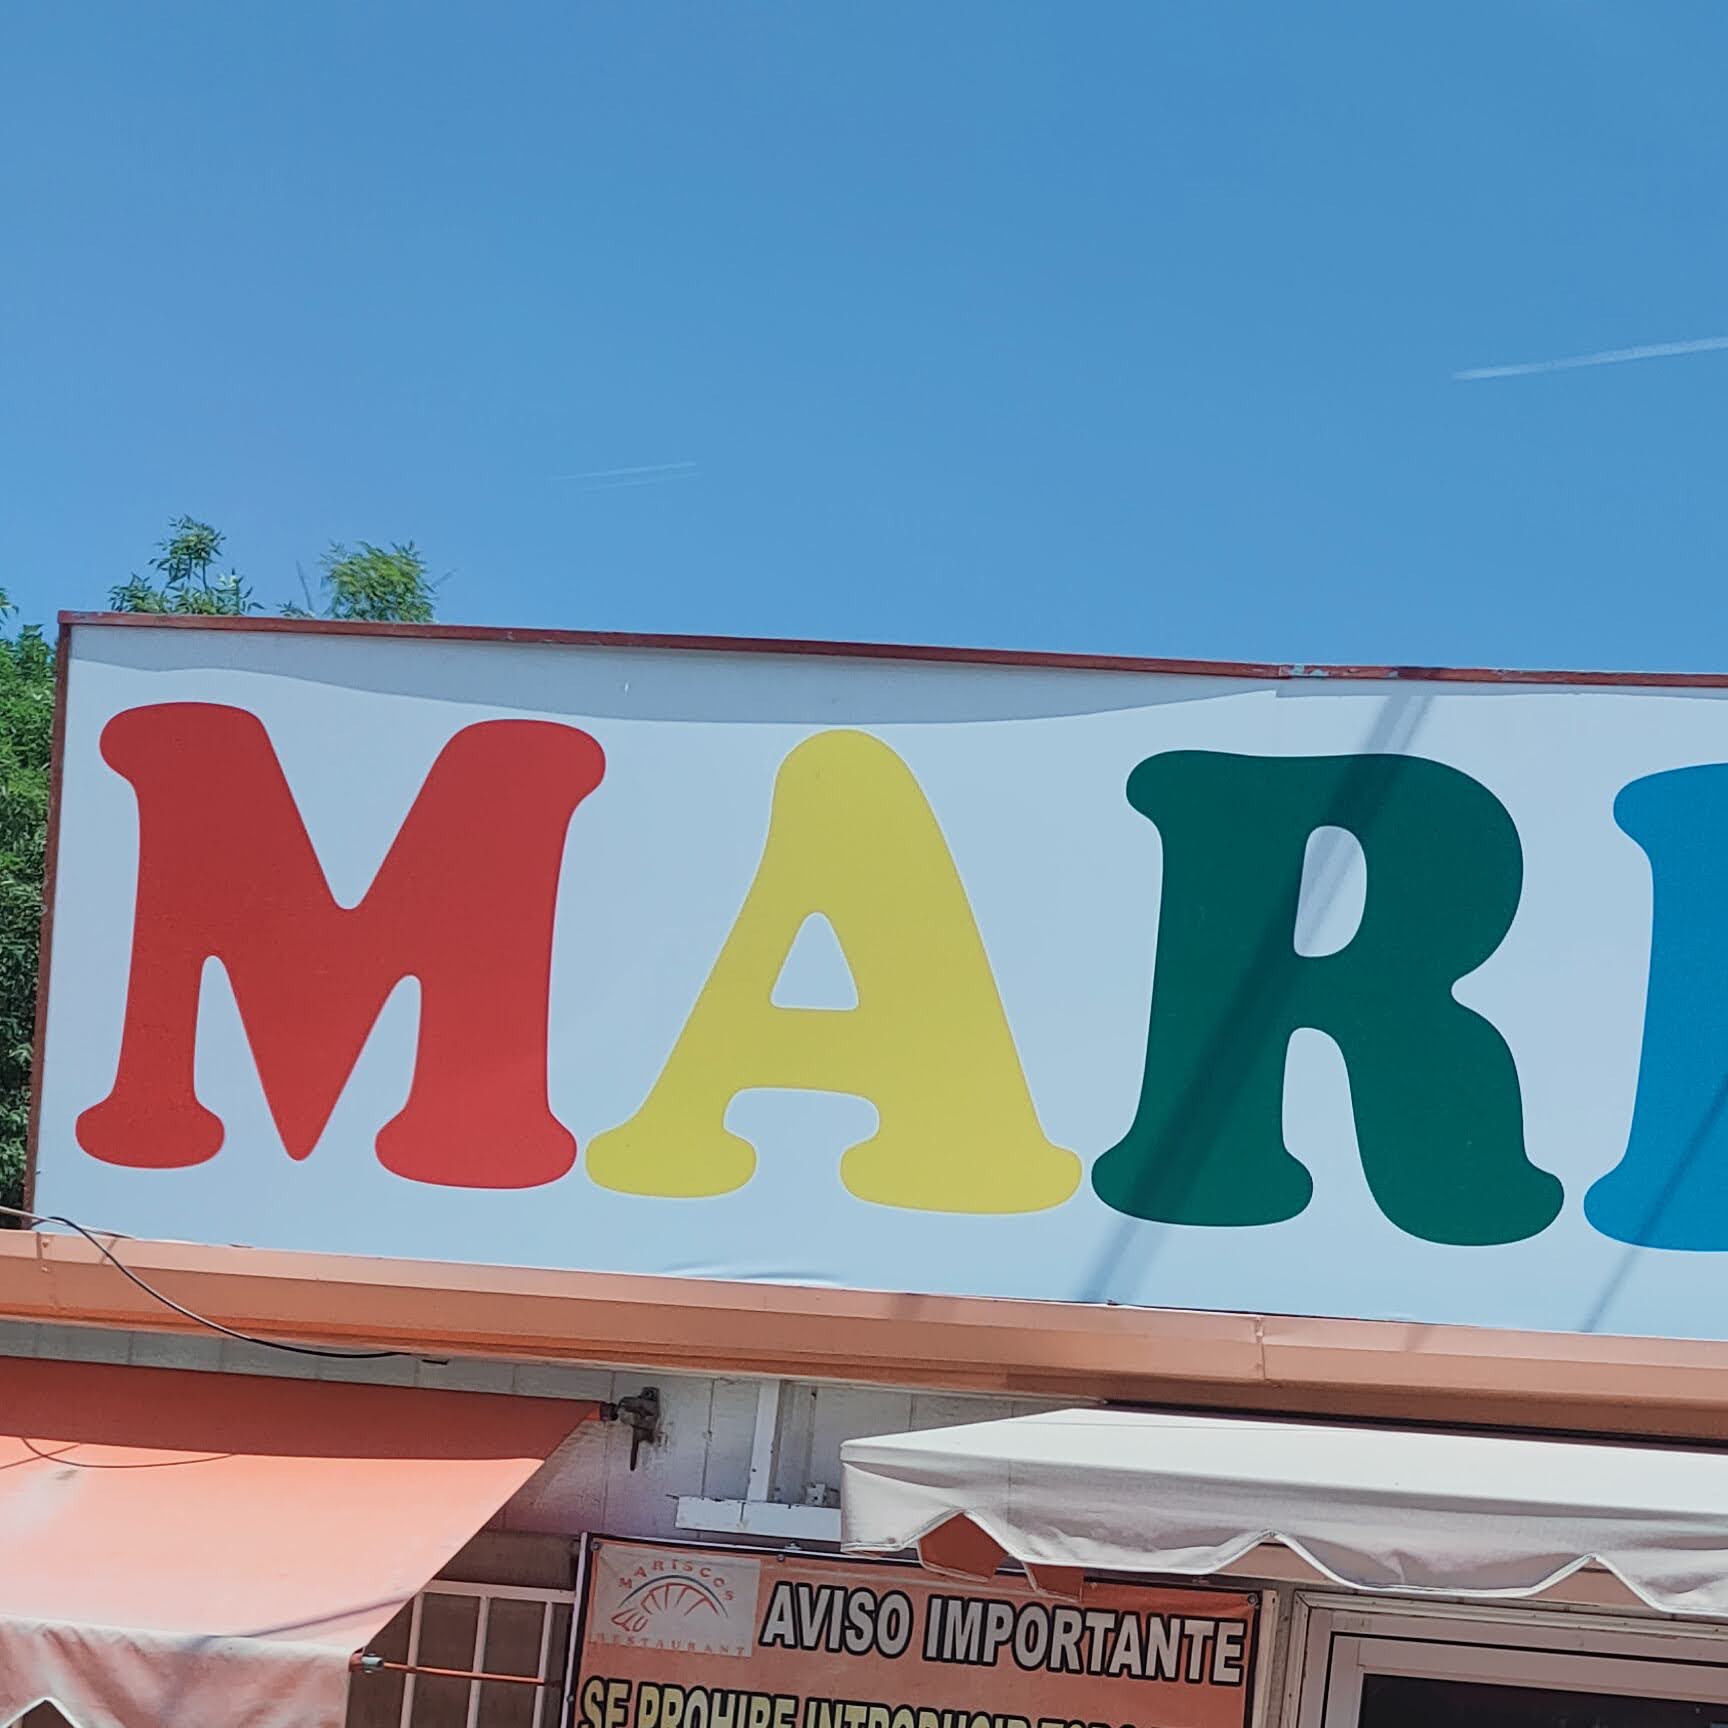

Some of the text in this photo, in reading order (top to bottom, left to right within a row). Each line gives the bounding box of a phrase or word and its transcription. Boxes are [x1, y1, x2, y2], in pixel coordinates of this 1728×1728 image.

[618, 1559, 735, 1601] MARISCOS
[760, 1583, 1247, 1686] AVISO IMPORTANTE
